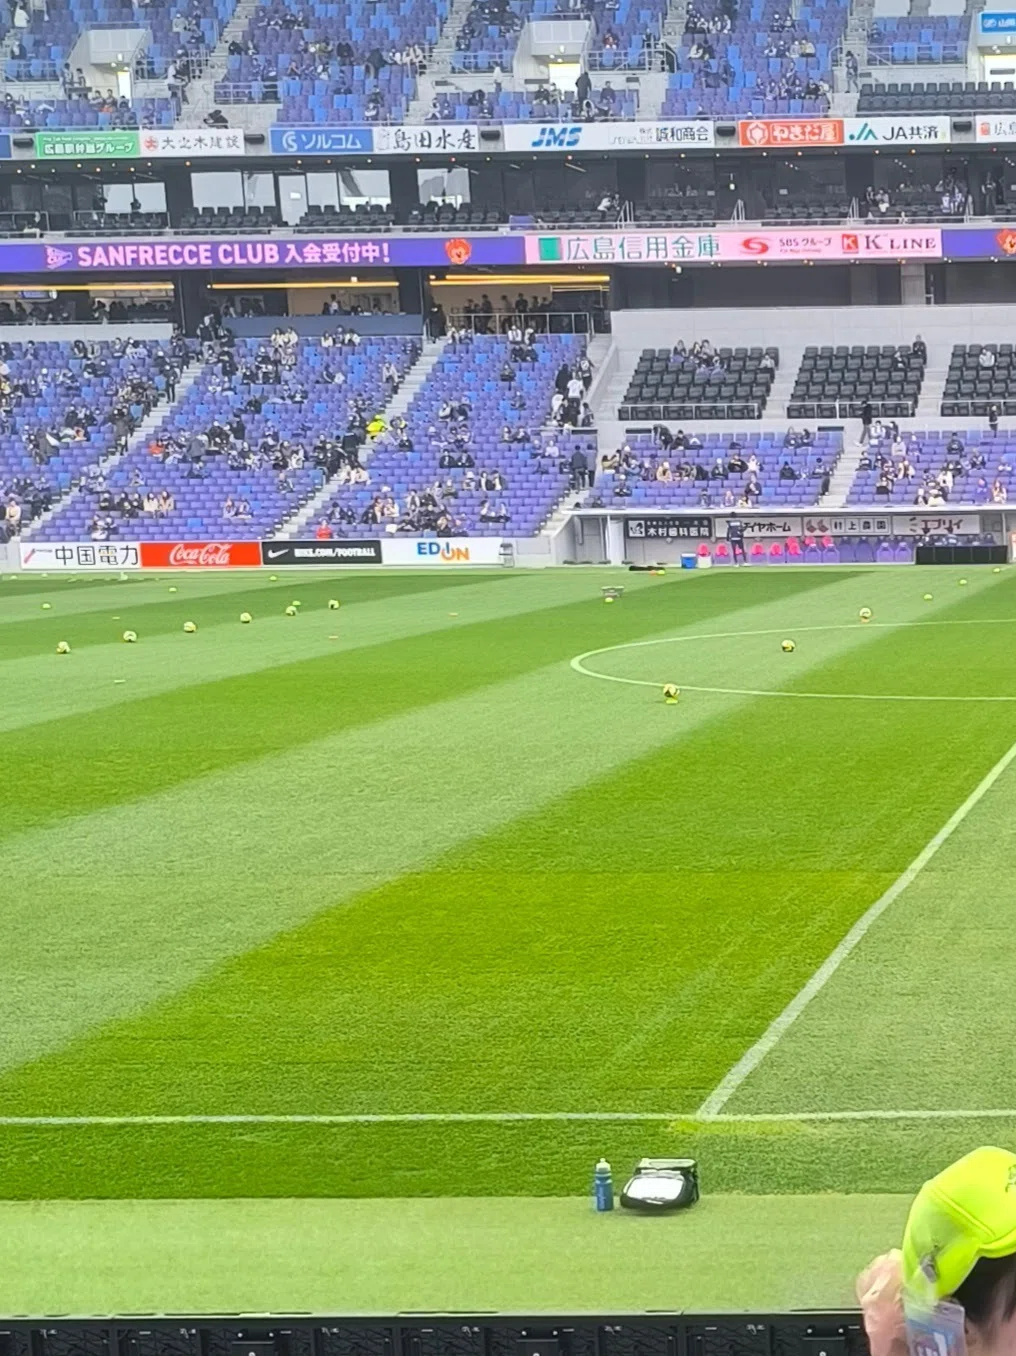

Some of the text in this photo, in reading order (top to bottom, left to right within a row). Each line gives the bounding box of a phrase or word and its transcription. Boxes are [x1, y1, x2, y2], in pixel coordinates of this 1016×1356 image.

[301, 133, 362, 149] ソルコム
[393, 129, 476, 150] 島田水産
[532, 127, 583, 147] JMS
[882, 126, 939, 140] JA共済
[567, 234, 721, 261] 広島信用金庫
[890, 237, 937, 250] LINE
[78, 243, 213, 267] SANFRECCE
[218, 242, 279, 265] CLUB
[647, 527, 709, 537] 木村歯科医院
[834, 520, 887, 530] 村上農園
[55, 545, 139, 566] 中国電力
[169, 543, 231, 565] Coca-Cola
[417, 541, 470, 561] EDION
